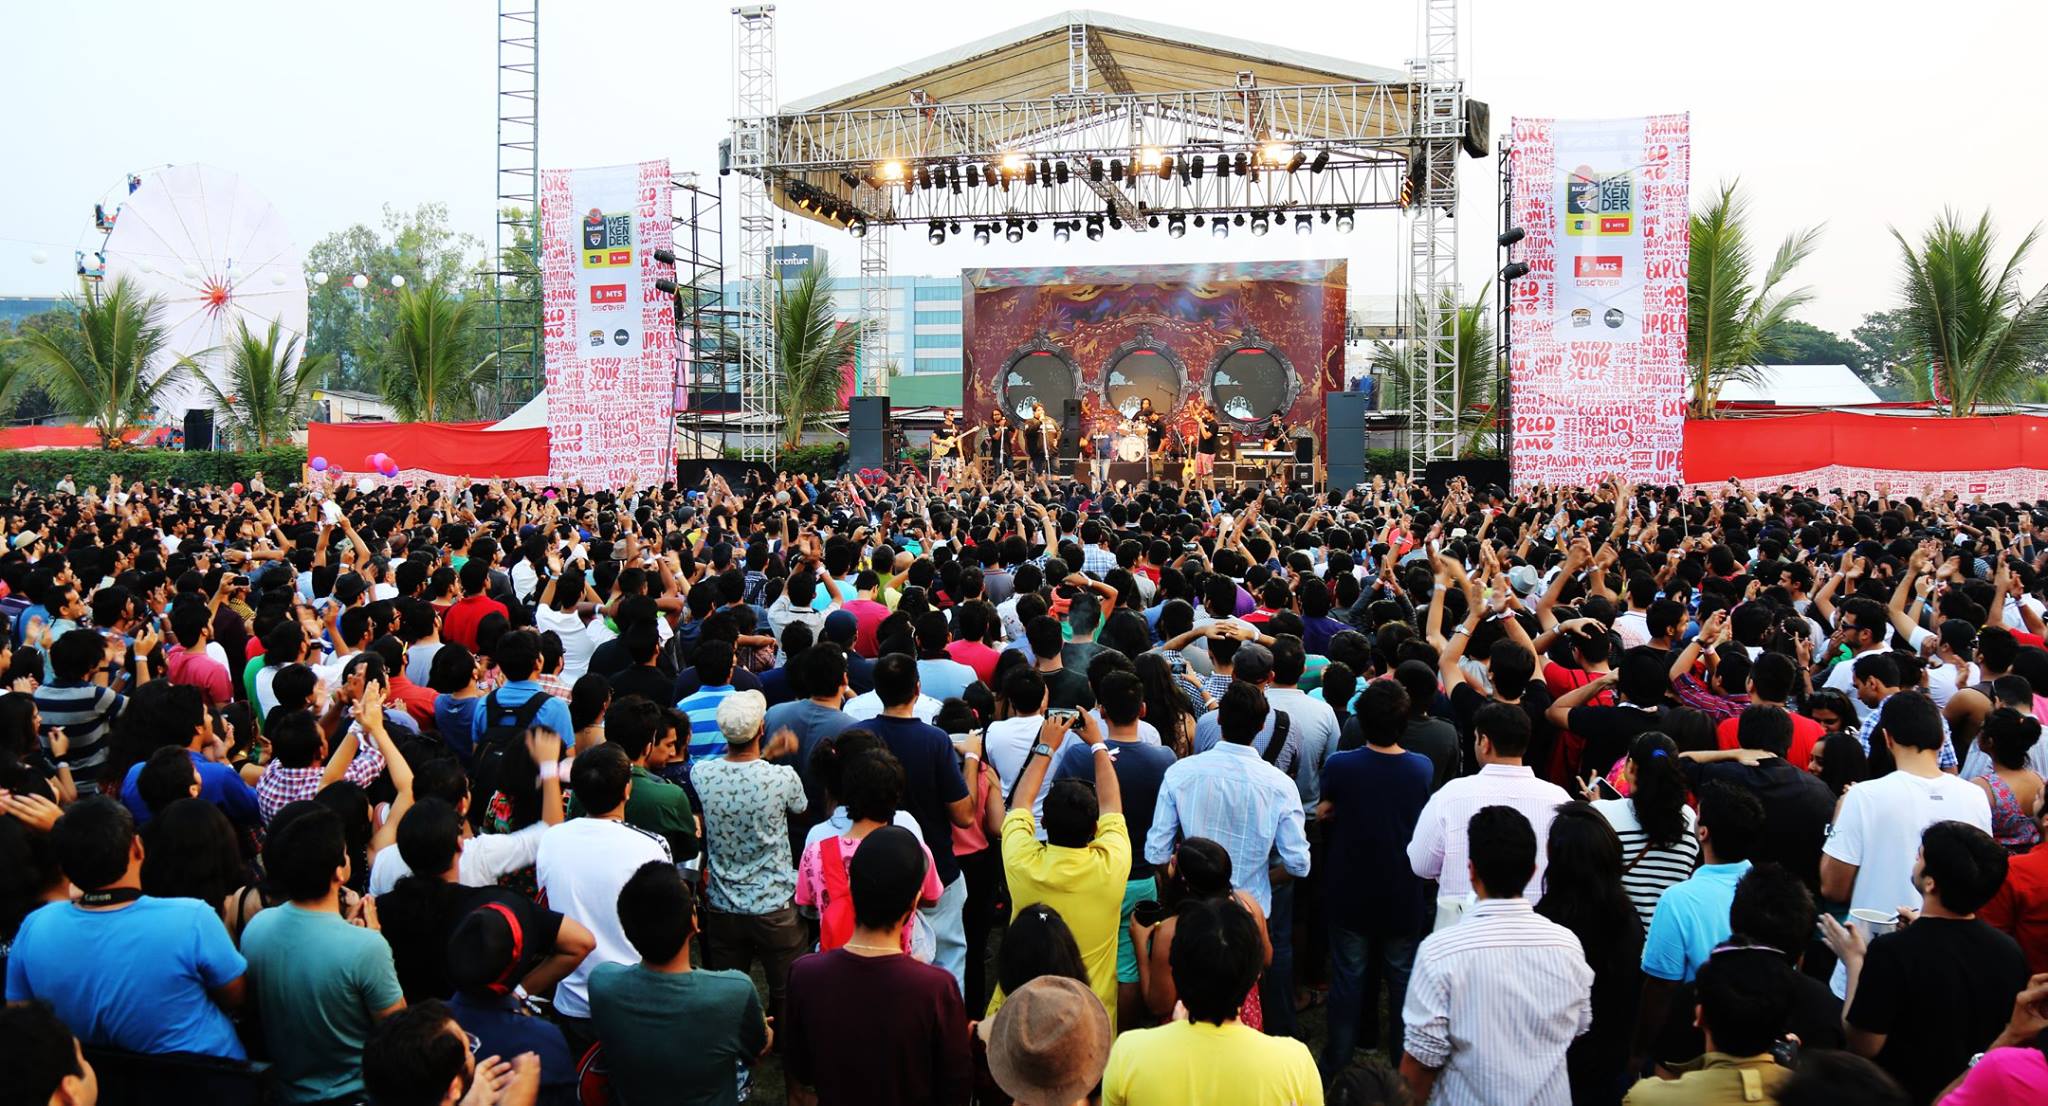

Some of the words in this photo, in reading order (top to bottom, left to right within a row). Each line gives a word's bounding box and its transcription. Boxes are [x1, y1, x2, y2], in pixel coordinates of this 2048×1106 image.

[1602, 187, 1630, 199] KEN
[1601, 199, 1630, 211] DER
[608, 215, 630, 226] WEE
[609, 225, 630, 236] KEN
[608, 235, 631, 247] DER
[773, 257, 809, 265] ccenture
[1596, 262, 1617, 270] MTS
[1576, 279, 1620, 287] DISCOVER
[592, 304, 625, 312] DISCOVER
[1570, 351, 1609, 368] YOUR
[1567, 364, 1607, 381] SELF
[1604, 405, 1633, 417] START
[1634, 414, 1657, 425] YOU
[1610, 418, 1634, 433] LOL
[1579, 426, 1609, 437] NEW
[1546, 454, 1586, 468] PASSION
